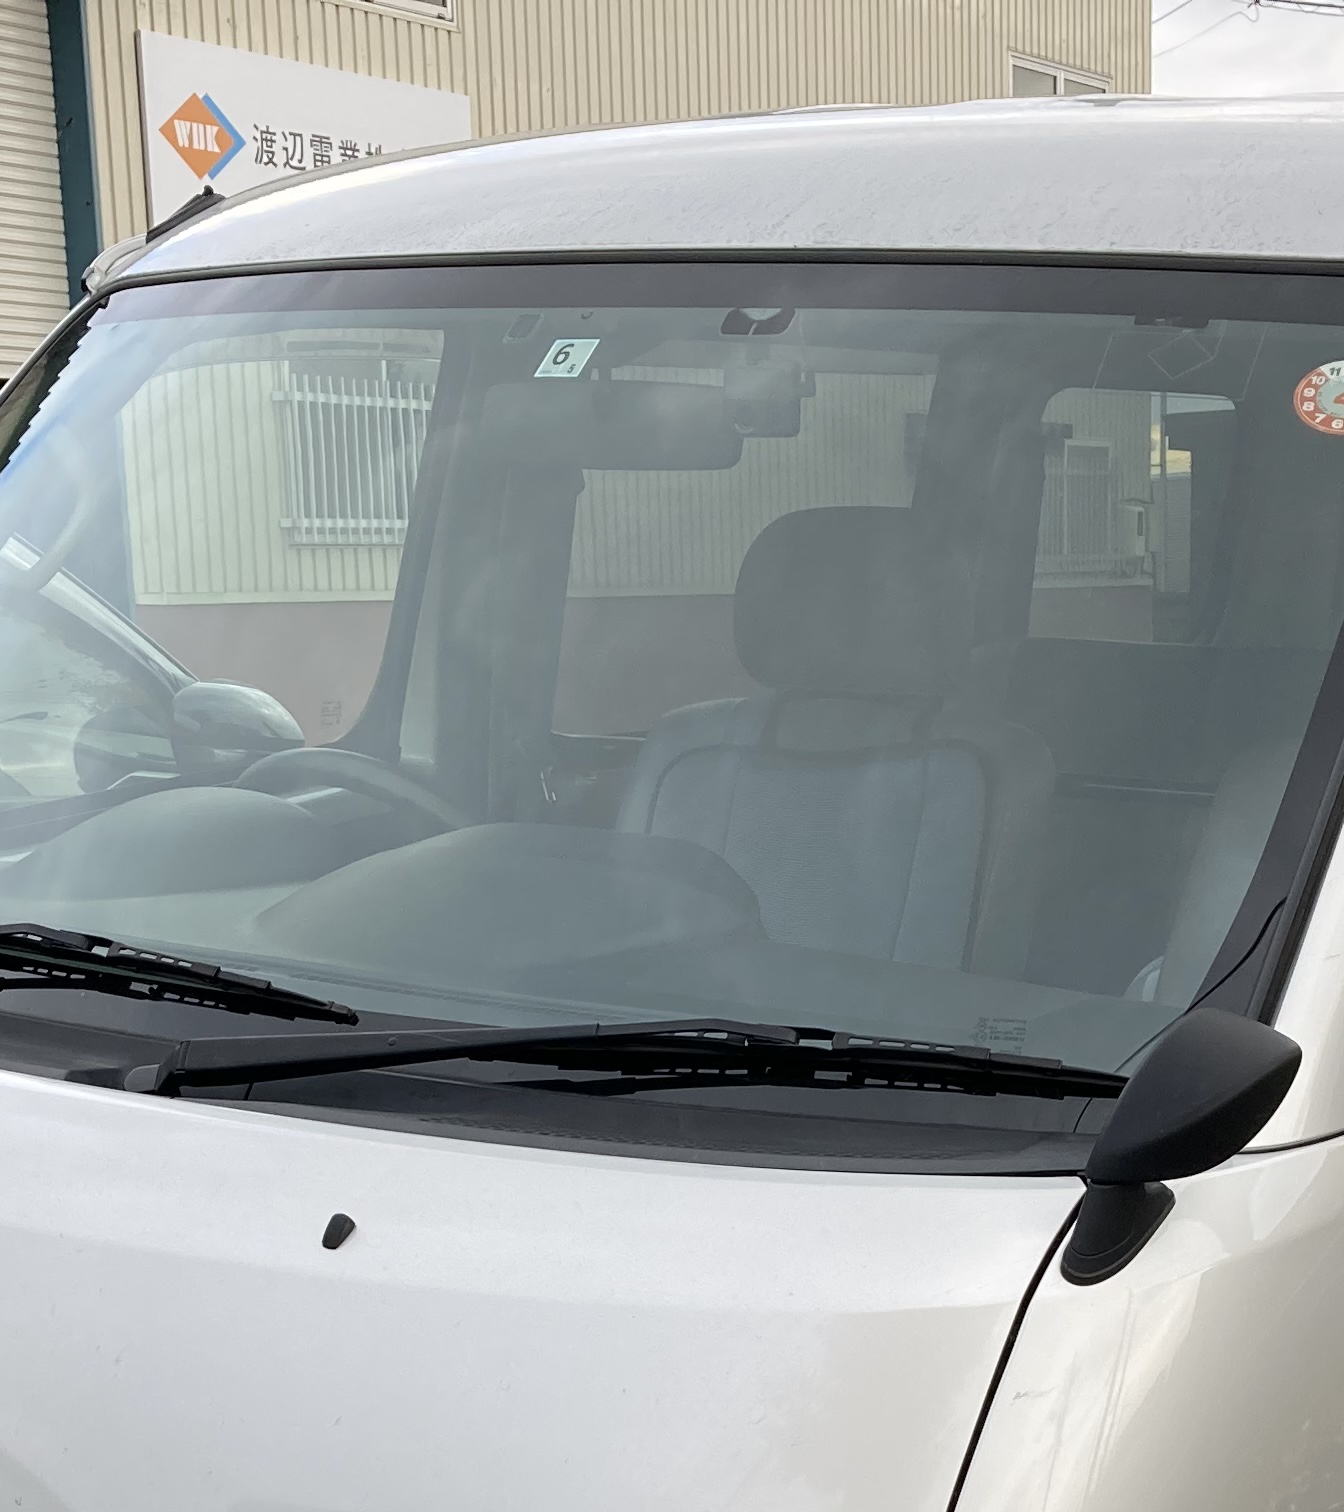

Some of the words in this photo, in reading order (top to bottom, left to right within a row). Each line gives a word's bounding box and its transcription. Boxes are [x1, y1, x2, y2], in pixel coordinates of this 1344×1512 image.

[553, 343, 575, 365] 6
[567, 364, 576, 373] 5
[1329, 367, 1342, 376] 11
[1311, 375, 1326, 385] 10
[1303, 387, 1316, 398] 9
[1302, 401, 1315, 411] 8
[1314, 413, 1327, 423] 7
[1331, 419, 1344, 429] 6
